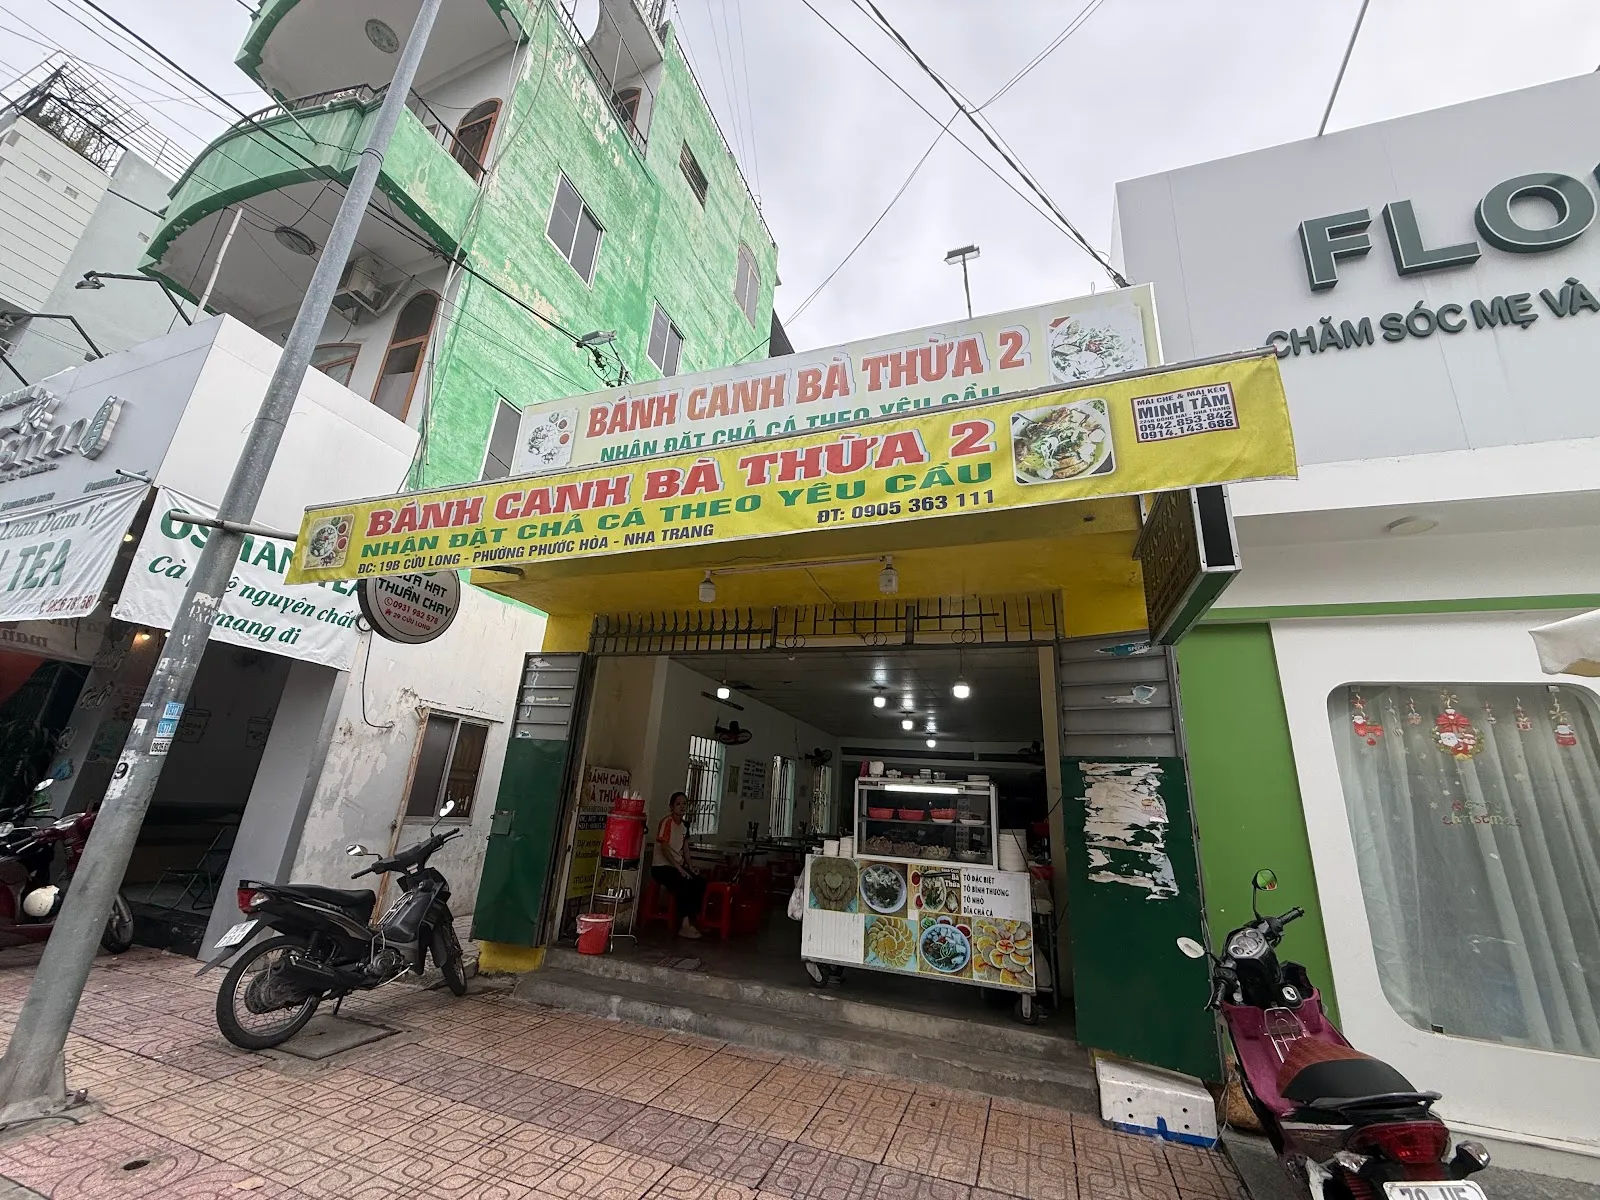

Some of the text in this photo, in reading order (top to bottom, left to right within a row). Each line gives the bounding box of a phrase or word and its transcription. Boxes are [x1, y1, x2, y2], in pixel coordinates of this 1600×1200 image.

[1298, 162, 1600, 291] FLO
[1266, 277, 1600, 358] CHĂM SÓC MẸ VÀ
[586, 330, 1026, 438] BÁNH CANH BÀ THỪA 2
[765, 415, 797, 436] CÁ
[806, 407, 870, 428] THEO
[880, 396, 931, 416] YÊU
[1138, 394, 1230, 419] MINH TÂM
[1140, 410, 1233, 432] 0942.853.842
[1209, 405, 1231, 413] TRANG
[1141, 419, 1234, 440] 0914.143.688
[366, 420, 993, 537] BÁNH CANH BÀ THỪA 2
[361, 462, 992, 558] NHẬN ĐẶT CHẢ CÁ THEO YÊU CẦU
[817, 489, 994, 524] ĐT: 0905 363 111
[7, 538, 72, 592] TEA
[380, 560, 401, 572] 19B
[404, 553, 425, 570] CỬU
[428, 553, 461, 567] LONG
[473, 545, 525, 563] PHƯỜNG
[529, 538, 576, 557] PHƯỚC
[579, 534, 608, 551] HÒA
[623, 531, 655, 547] NHA
[661, 524, 714, 542] TRANG
[148, 555, 188, 580] Cà
[238, 583, 317, 617] nguyên
[316, 608, 357, 630] chất
[379, 577, 421, 605] THUẦN
[422, 597, 452, 617] CHAY
[392, 600, 411, 613] 0931
[424, 580, 447, 599] HẠT
[213, 610, 302, 646] mang đi
[610, 773, 630, 787] CANH
